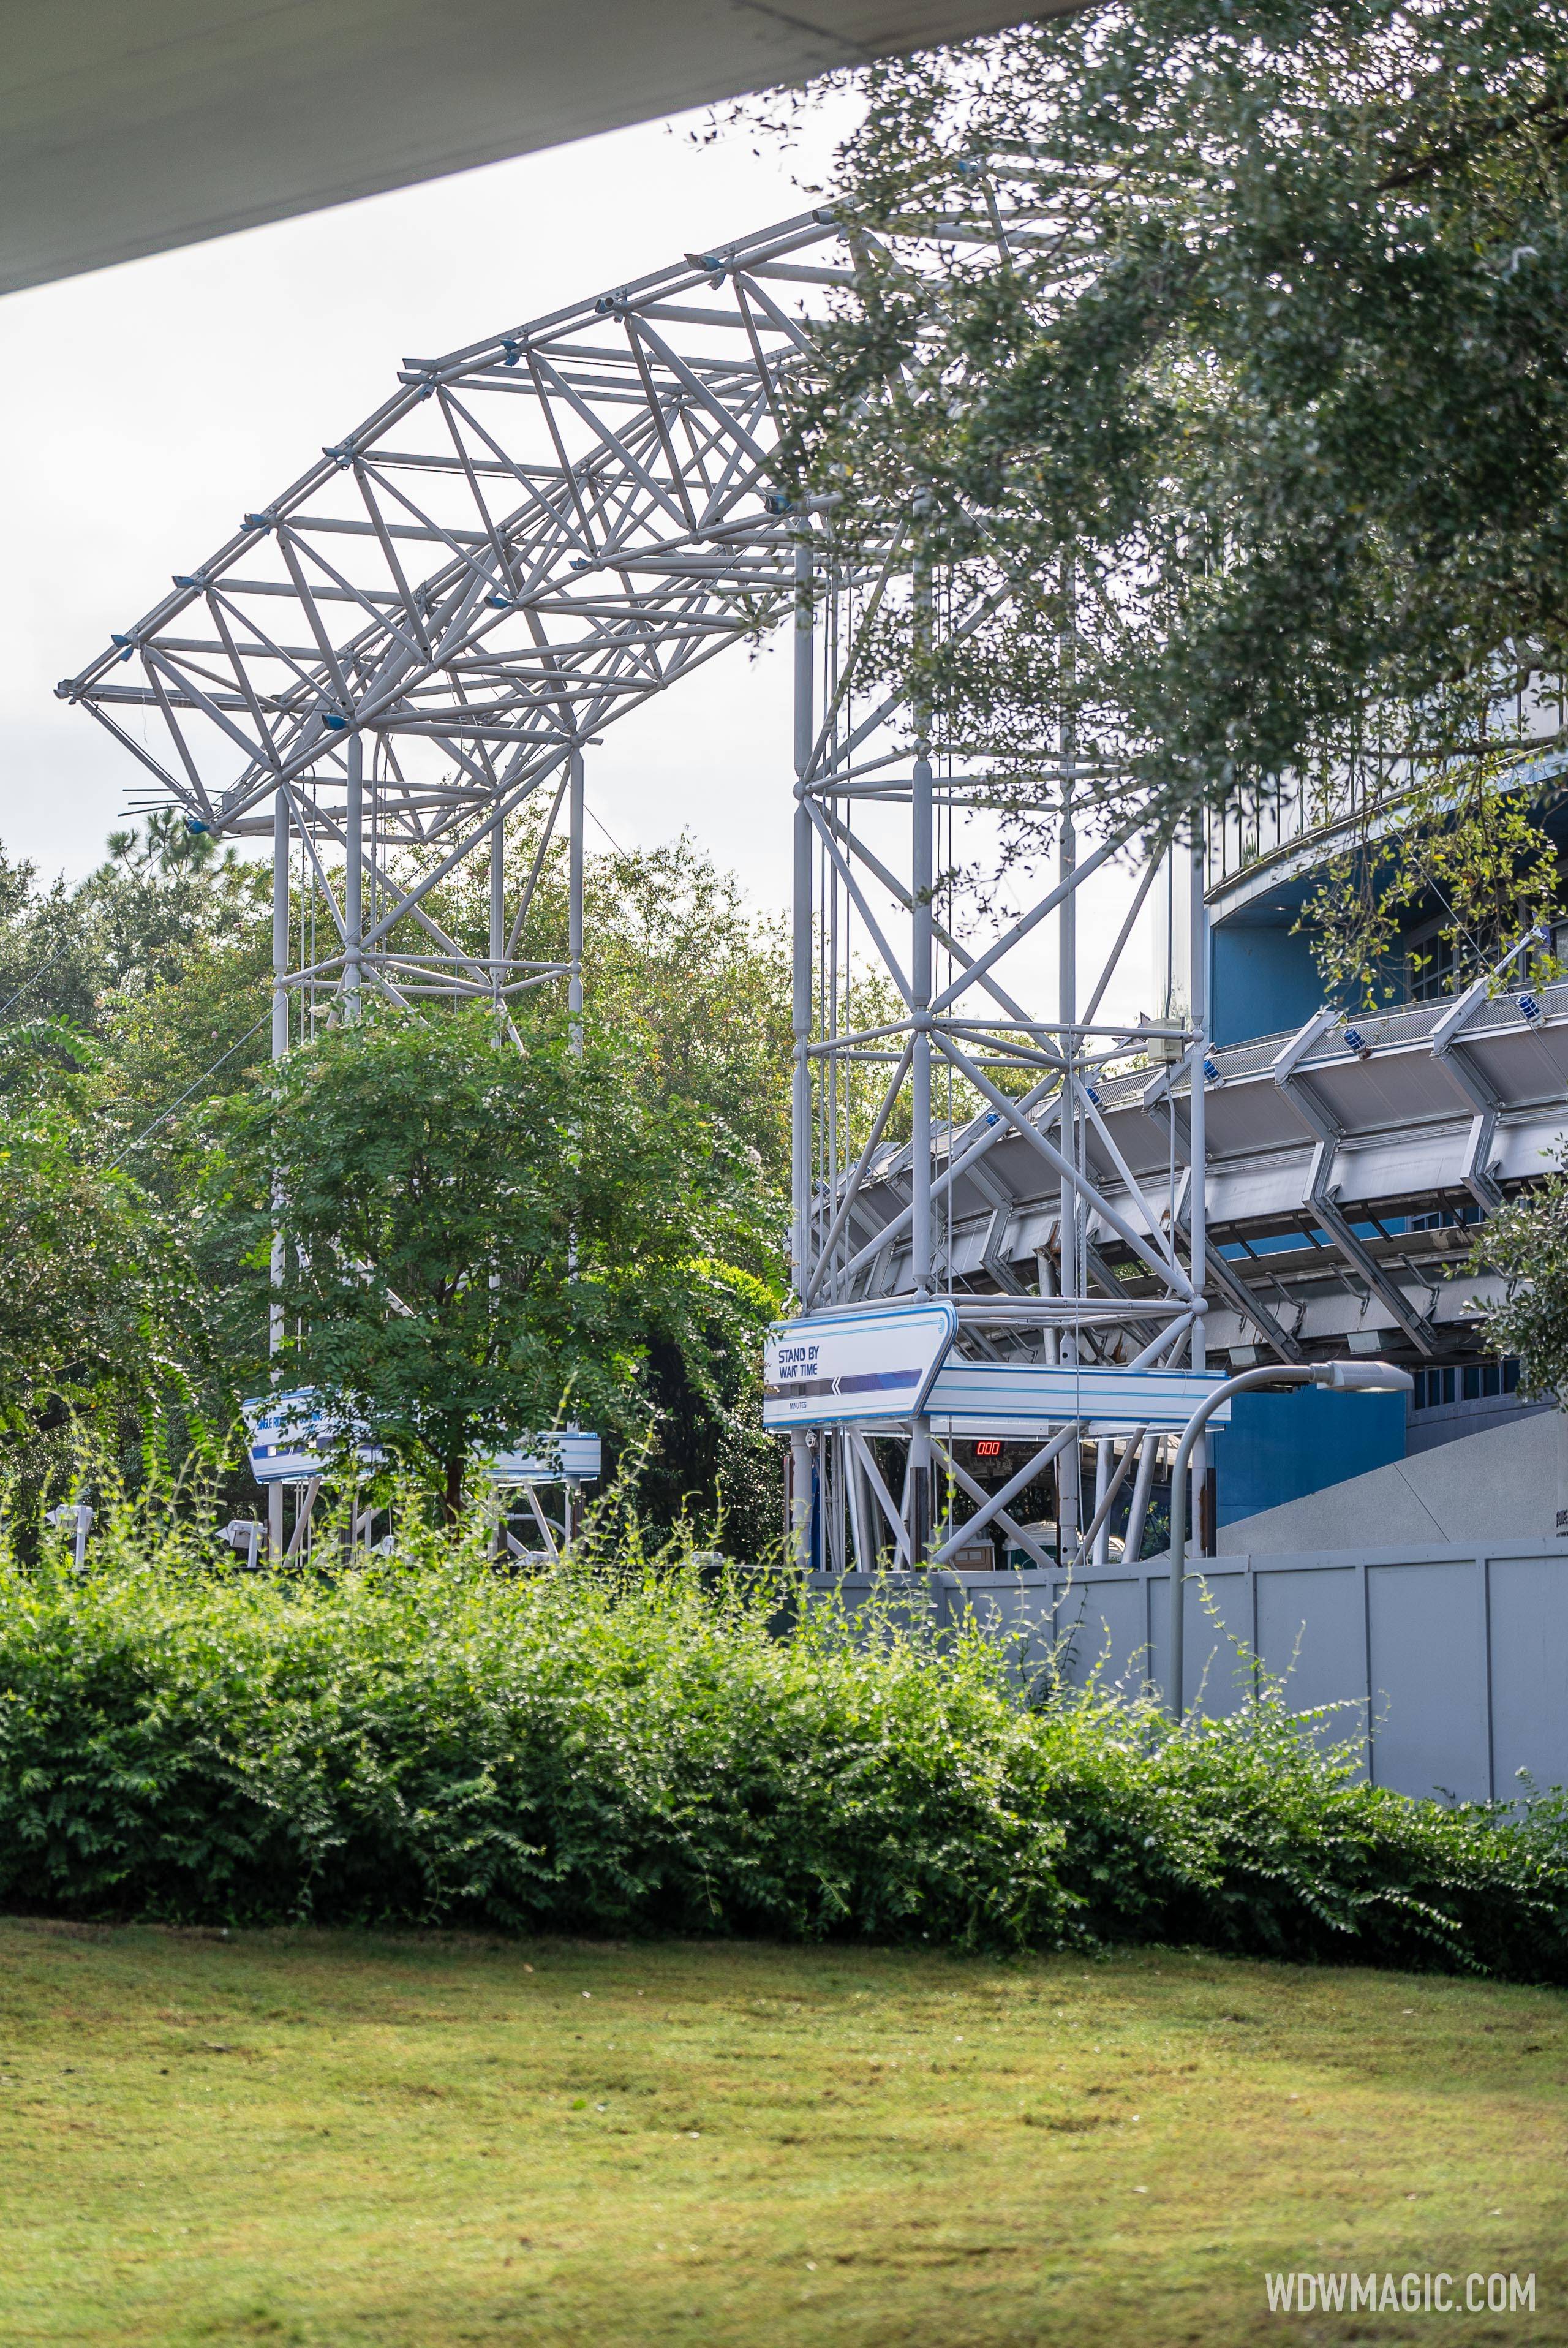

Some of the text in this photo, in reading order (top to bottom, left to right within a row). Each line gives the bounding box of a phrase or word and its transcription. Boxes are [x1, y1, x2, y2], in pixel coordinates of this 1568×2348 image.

[778, 1345, 820, 1364] STAND BY
[779, 1363, 818, 1379] WAIT TIME
[977, 1441, 1000, 1455] 000
